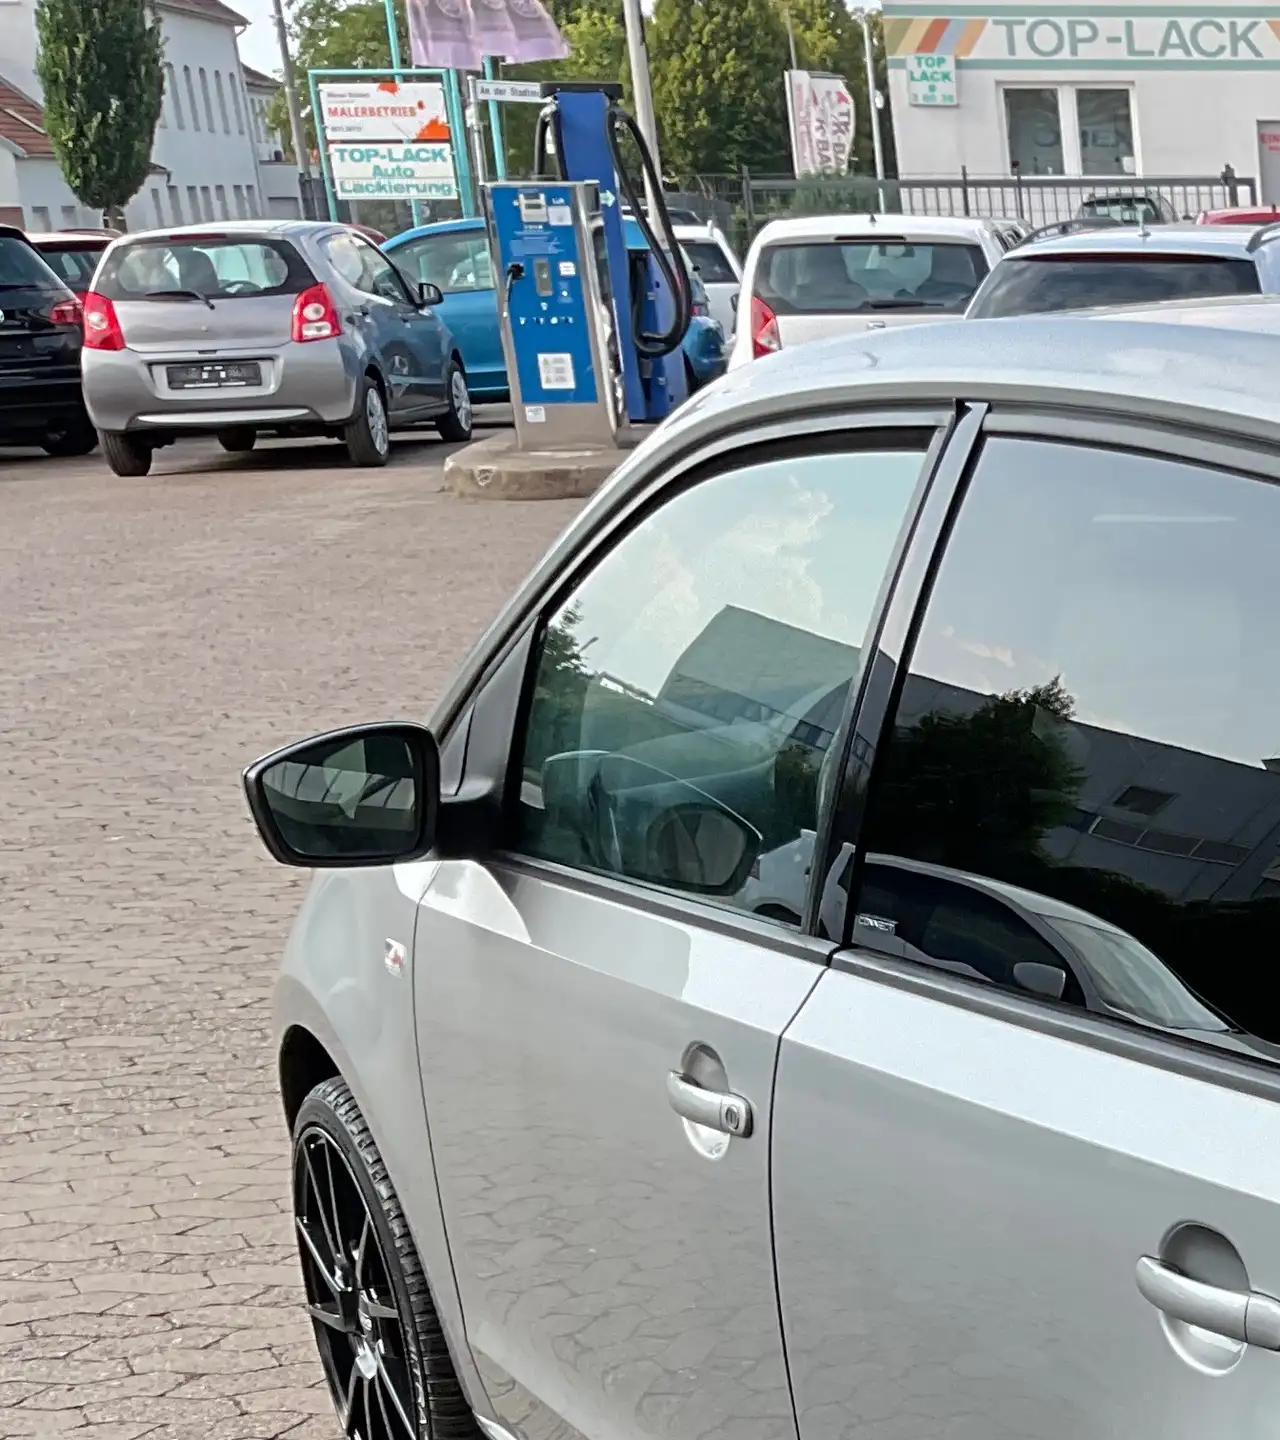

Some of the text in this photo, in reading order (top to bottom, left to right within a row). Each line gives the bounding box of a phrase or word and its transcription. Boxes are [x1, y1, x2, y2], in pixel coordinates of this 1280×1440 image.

[992, 18, 1263, 58] TOP-LACK
[915, 56, 946, 68] TOP
[910, 70, 951, 82] LACK
[328, 106, 416, 117] MALERBETRIEB
[335, 147, 448, 162] TOP-LACK
[372, 164, 415, 179] Auto
[339, 179, 455, 195] Lackierung
